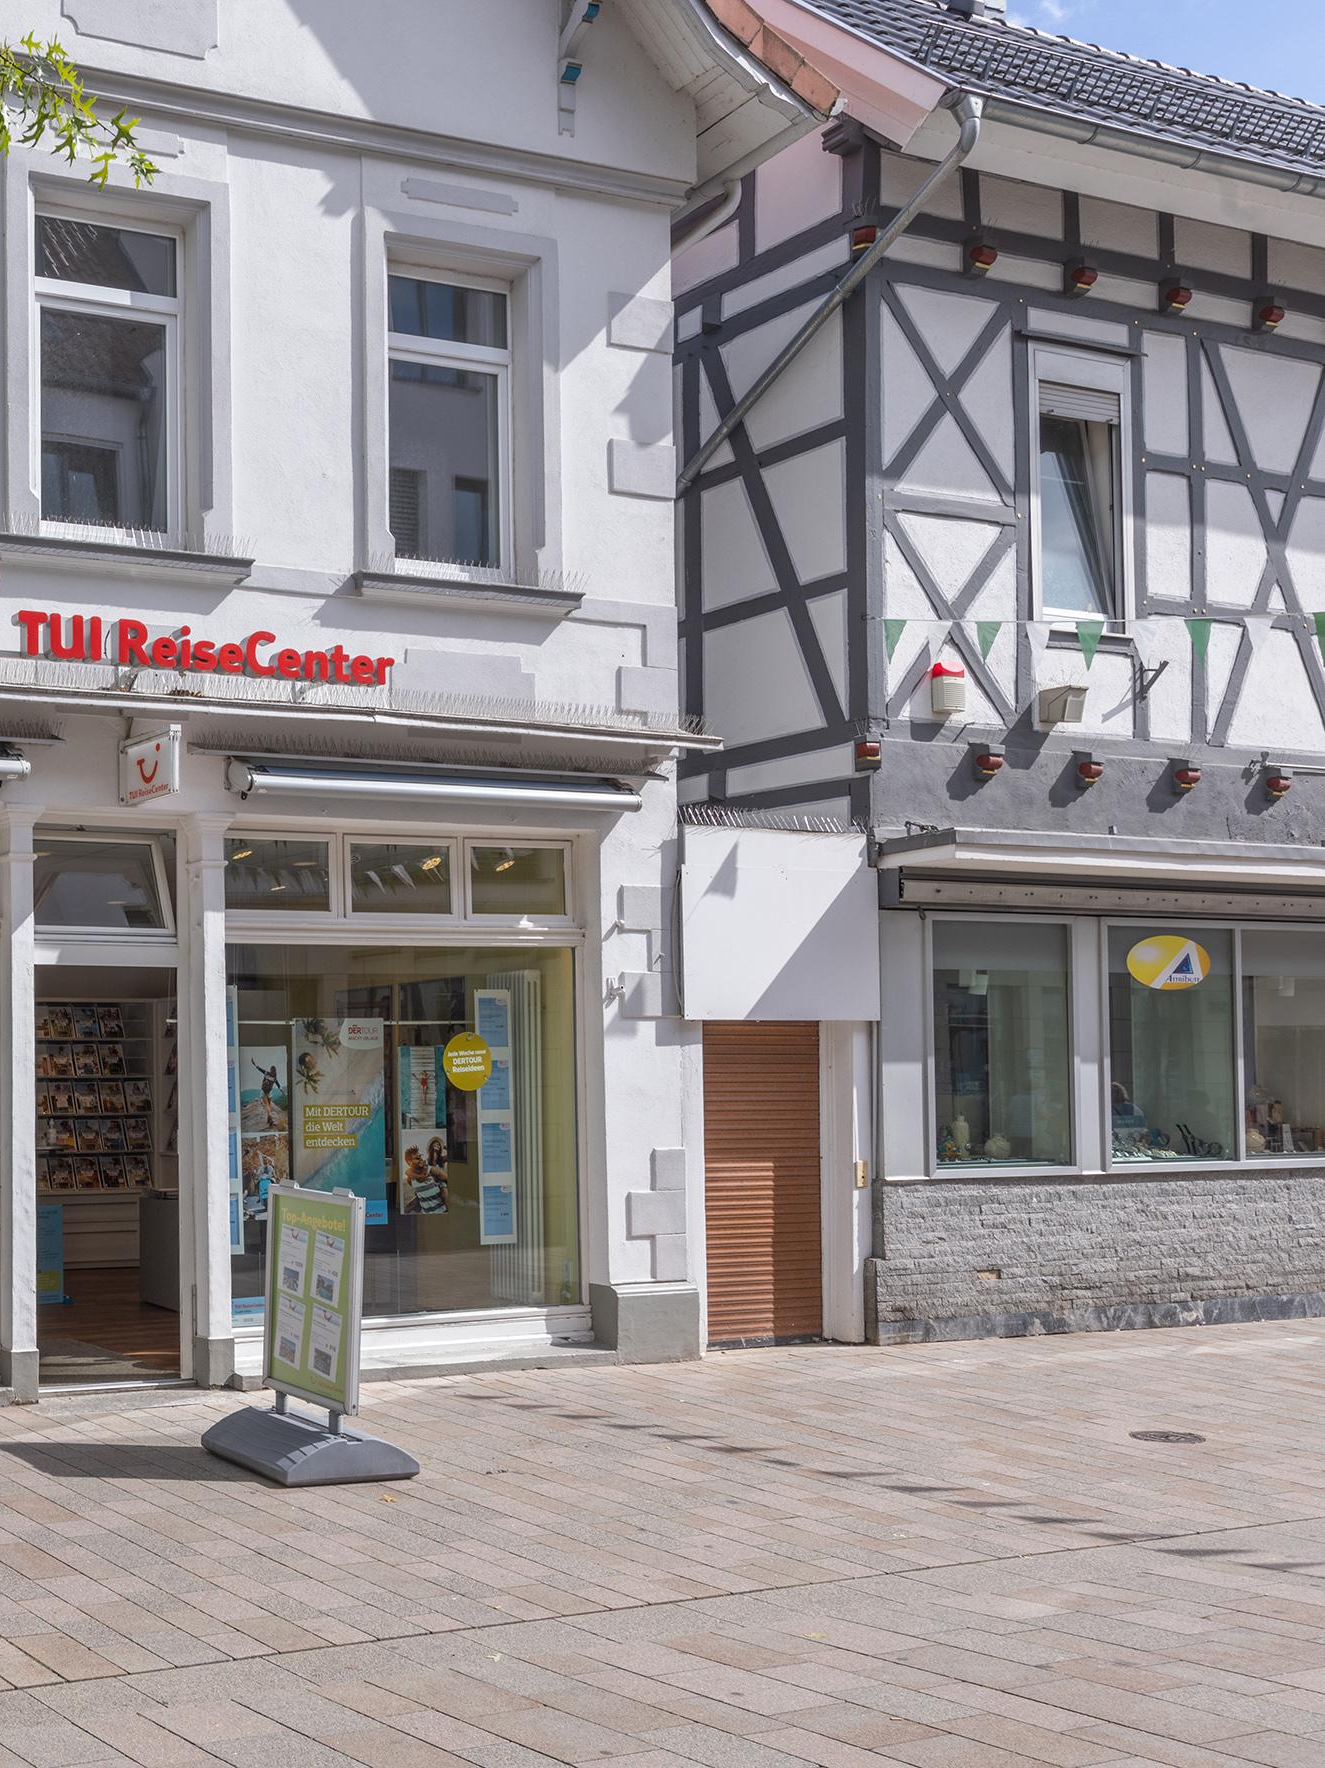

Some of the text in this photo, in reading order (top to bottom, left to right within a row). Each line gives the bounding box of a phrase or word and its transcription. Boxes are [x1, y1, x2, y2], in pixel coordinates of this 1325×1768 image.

[13, 610, 395, 686] TUI ReiseCenter
[129, 783, 169, 800] TUI ReiseCenter
[452, 1056, 483, 1065] DERTOUR
[452, 1065, 485, 1073] Reiseideen
[305, 1106, 369, 1117] Mit DERTOUR
[305, 1121, 344, 1132] die Welt
[306, 1137, 356, 1148] entdecken
